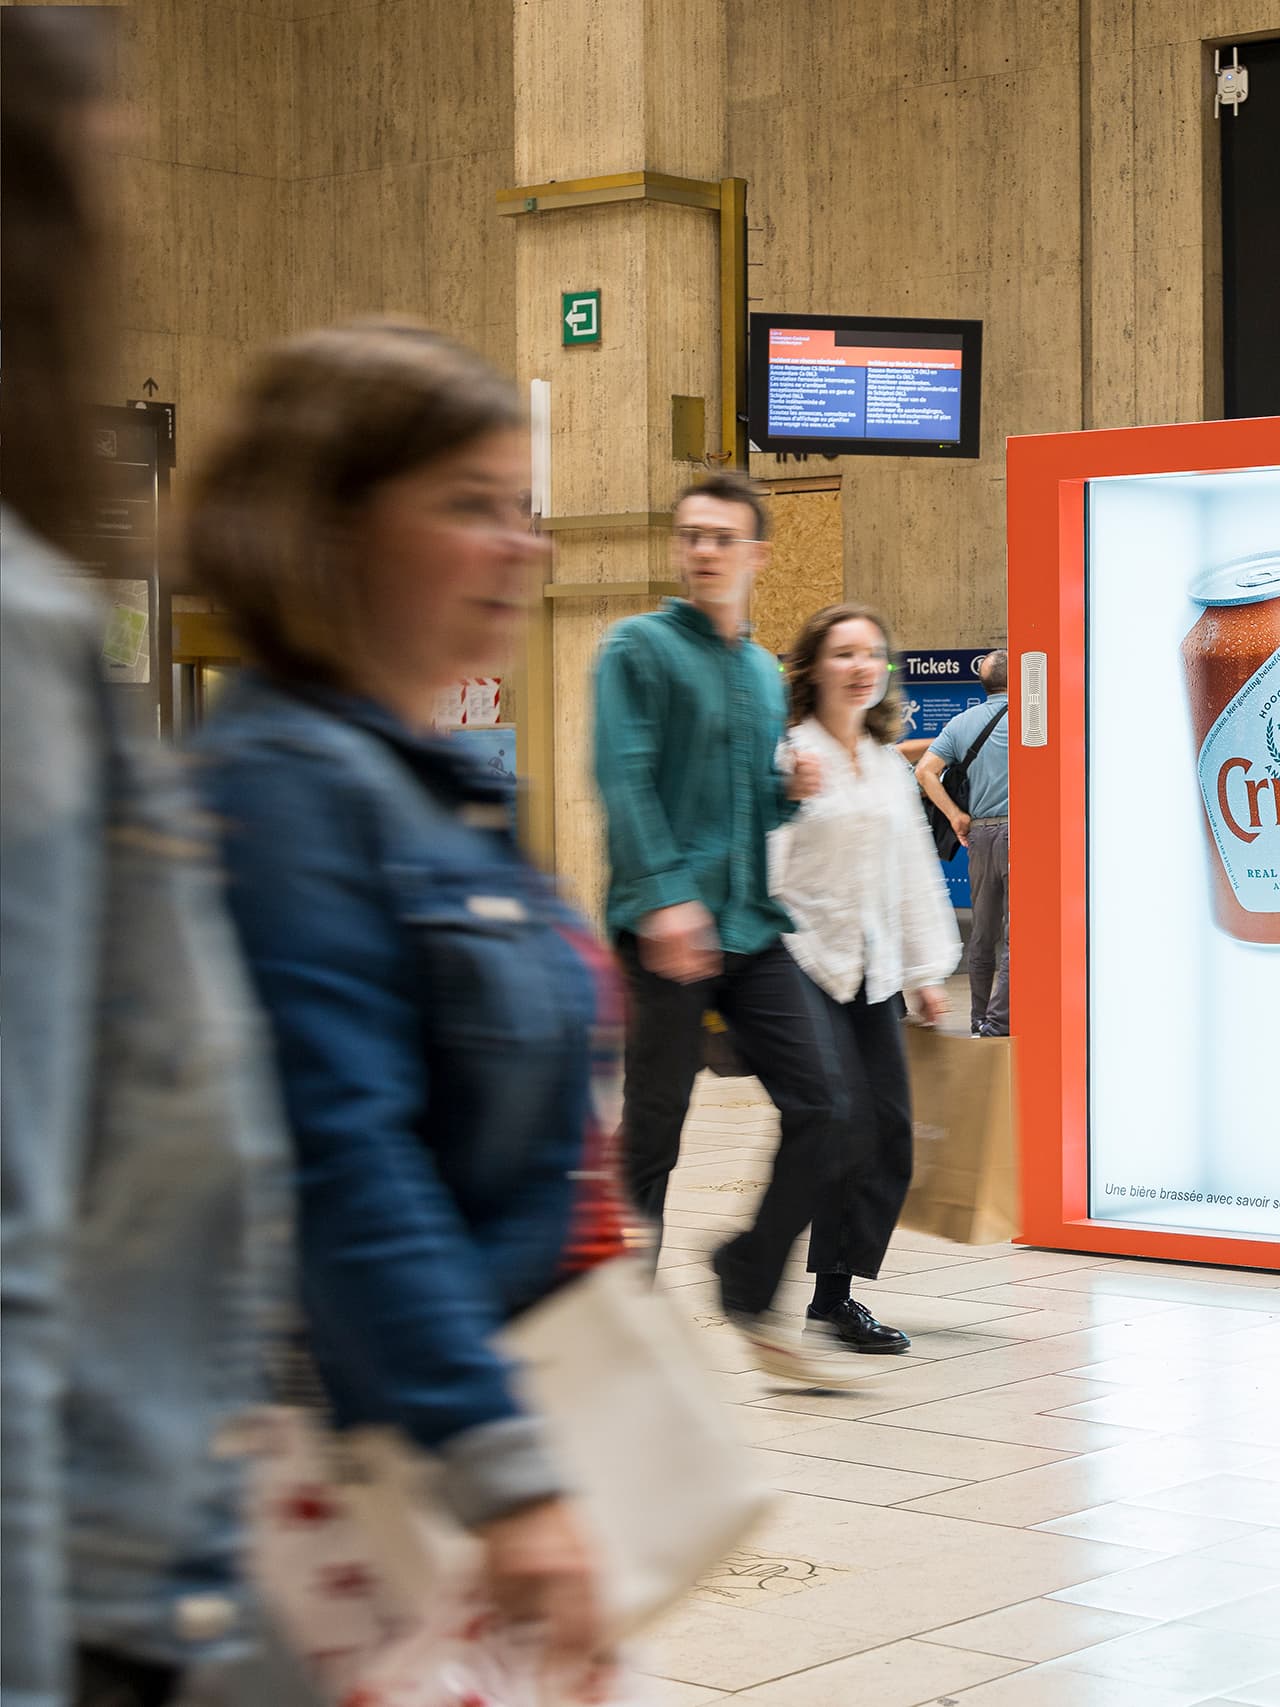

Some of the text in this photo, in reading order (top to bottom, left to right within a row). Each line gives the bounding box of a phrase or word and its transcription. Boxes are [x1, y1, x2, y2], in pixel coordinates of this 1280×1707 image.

[906, 657, 960, 675] Tickets
[1247, 867, 1278, 879] REAL
[1105, 1183, 1127, 1196] Une
[1130, 1185, 1157, 1199] bière
[1159, 1188, 1204, 1203] brassée
[1206, 1194, 1233, 1206] avec
[1236, 1196, 1270, 1209] savoir
